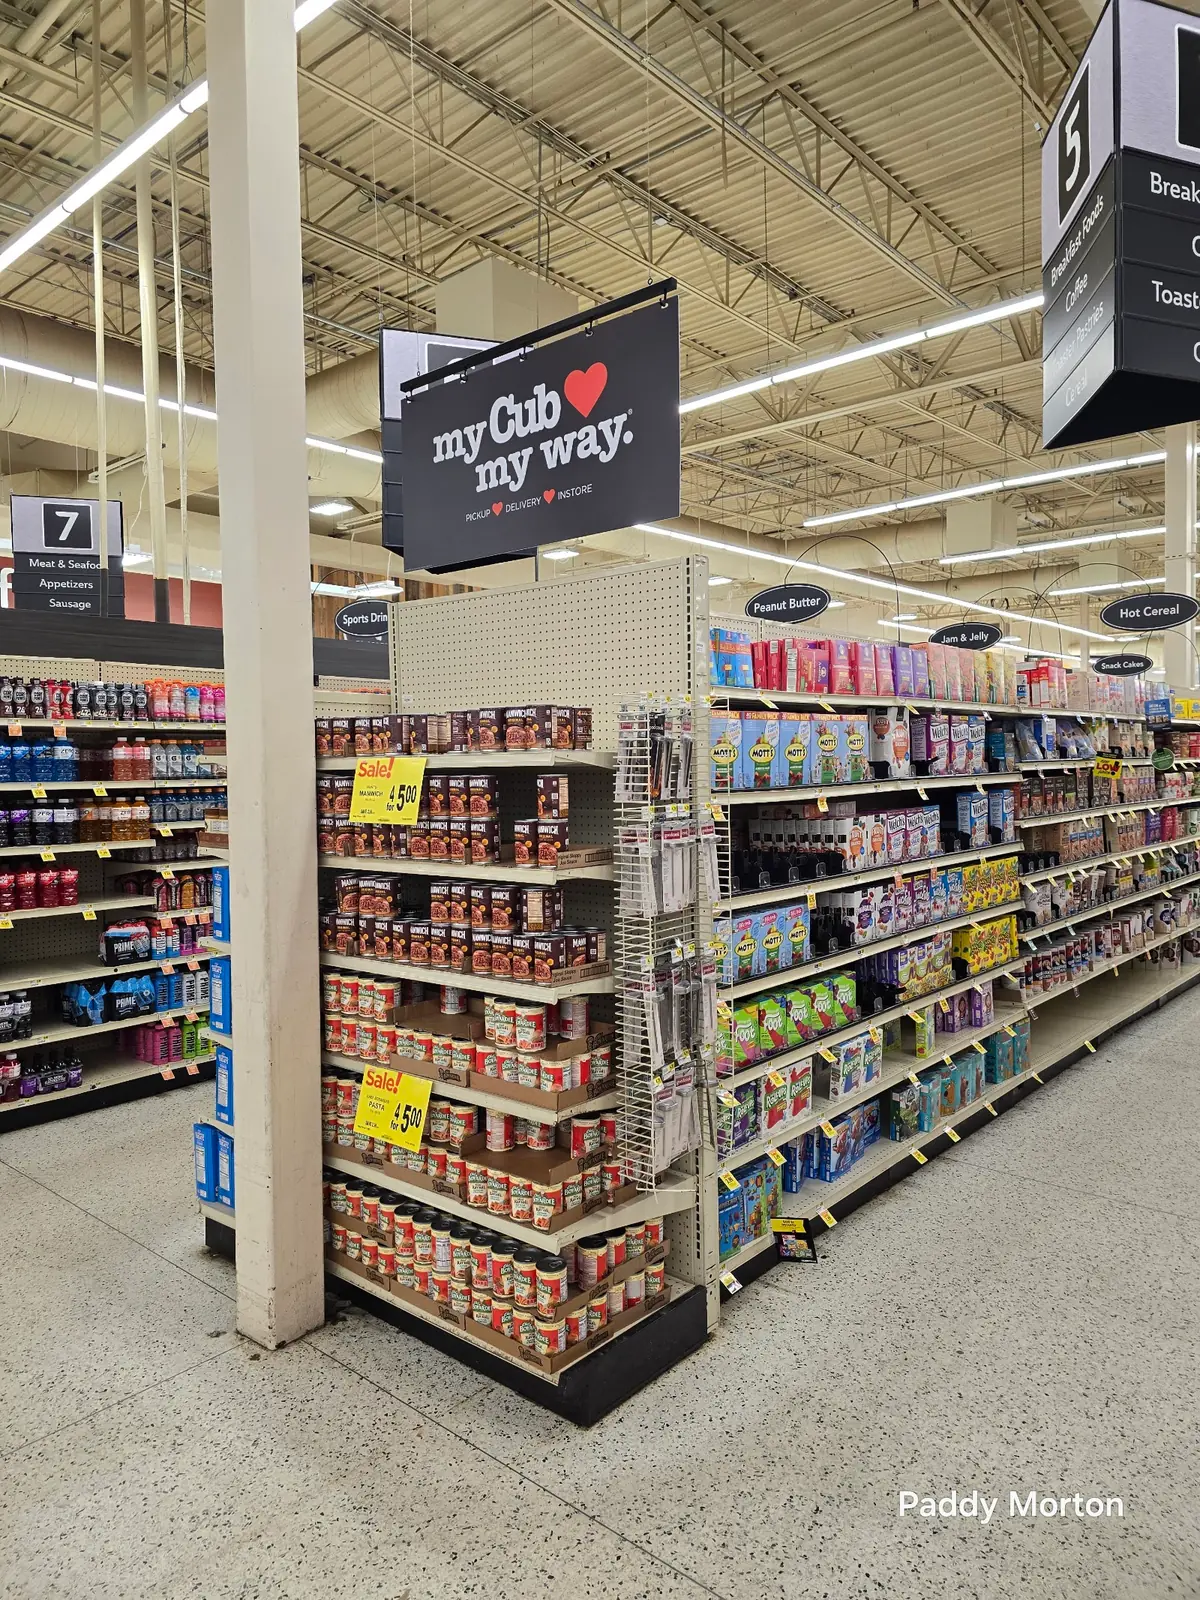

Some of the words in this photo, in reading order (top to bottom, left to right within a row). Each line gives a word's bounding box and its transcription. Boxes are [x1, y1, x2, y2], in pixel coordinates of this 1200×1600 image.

[1065, 100, 1081, 192] 5
[1051, 231, 1082, 287] Breakfast
[1082, 195, 1104, 239] Foods
[1065, 273, 1088, 313] Coffee
[1076, 302, 1104, 346] Pastries
[475, 447, 533, 492] my
[465, 509, 491, 522] PICKUP
[505, 497, 541, 513] DELIVERY
[557, 484, 593, 500] INSTORE
[55, 511, 79, 541] 7
[29, 559, 55, 568] Meat
[58, 560, 66, 568] &
[68, 560, 101, 569] Seafoo
[39, 579, 93, 589] Appetizers
[49, 599, 91, 610] Sausage
[754, 601, 787, 614] Peanut
[789, 597, 821, 609] Butter
[1120, 607, 1141, 619] Hot
[1143, 604, 1180, 617] Cereal
[343, 614, 369, 627] Sports
[370, 612, 388, 622] Drin
[940, 635, 959, 644] Jam
[961, 633, 968, 642] &
[970, 631, 989, 643] Jelly
[1101, 662, 1120, 670] Snack
[1123, 660, 1144, 669] Cakes
[358, 756, 395, 779] Sale!
[389, 785, 395, 802] 4
[386, 802, 395, 811] for
[366, 1070, 403, 1094] Sale!
[368, 1101, 385, 1111] PASTA
[394, 1103, 401, 1120] 4
[390, 1120, 398, 1131] for
